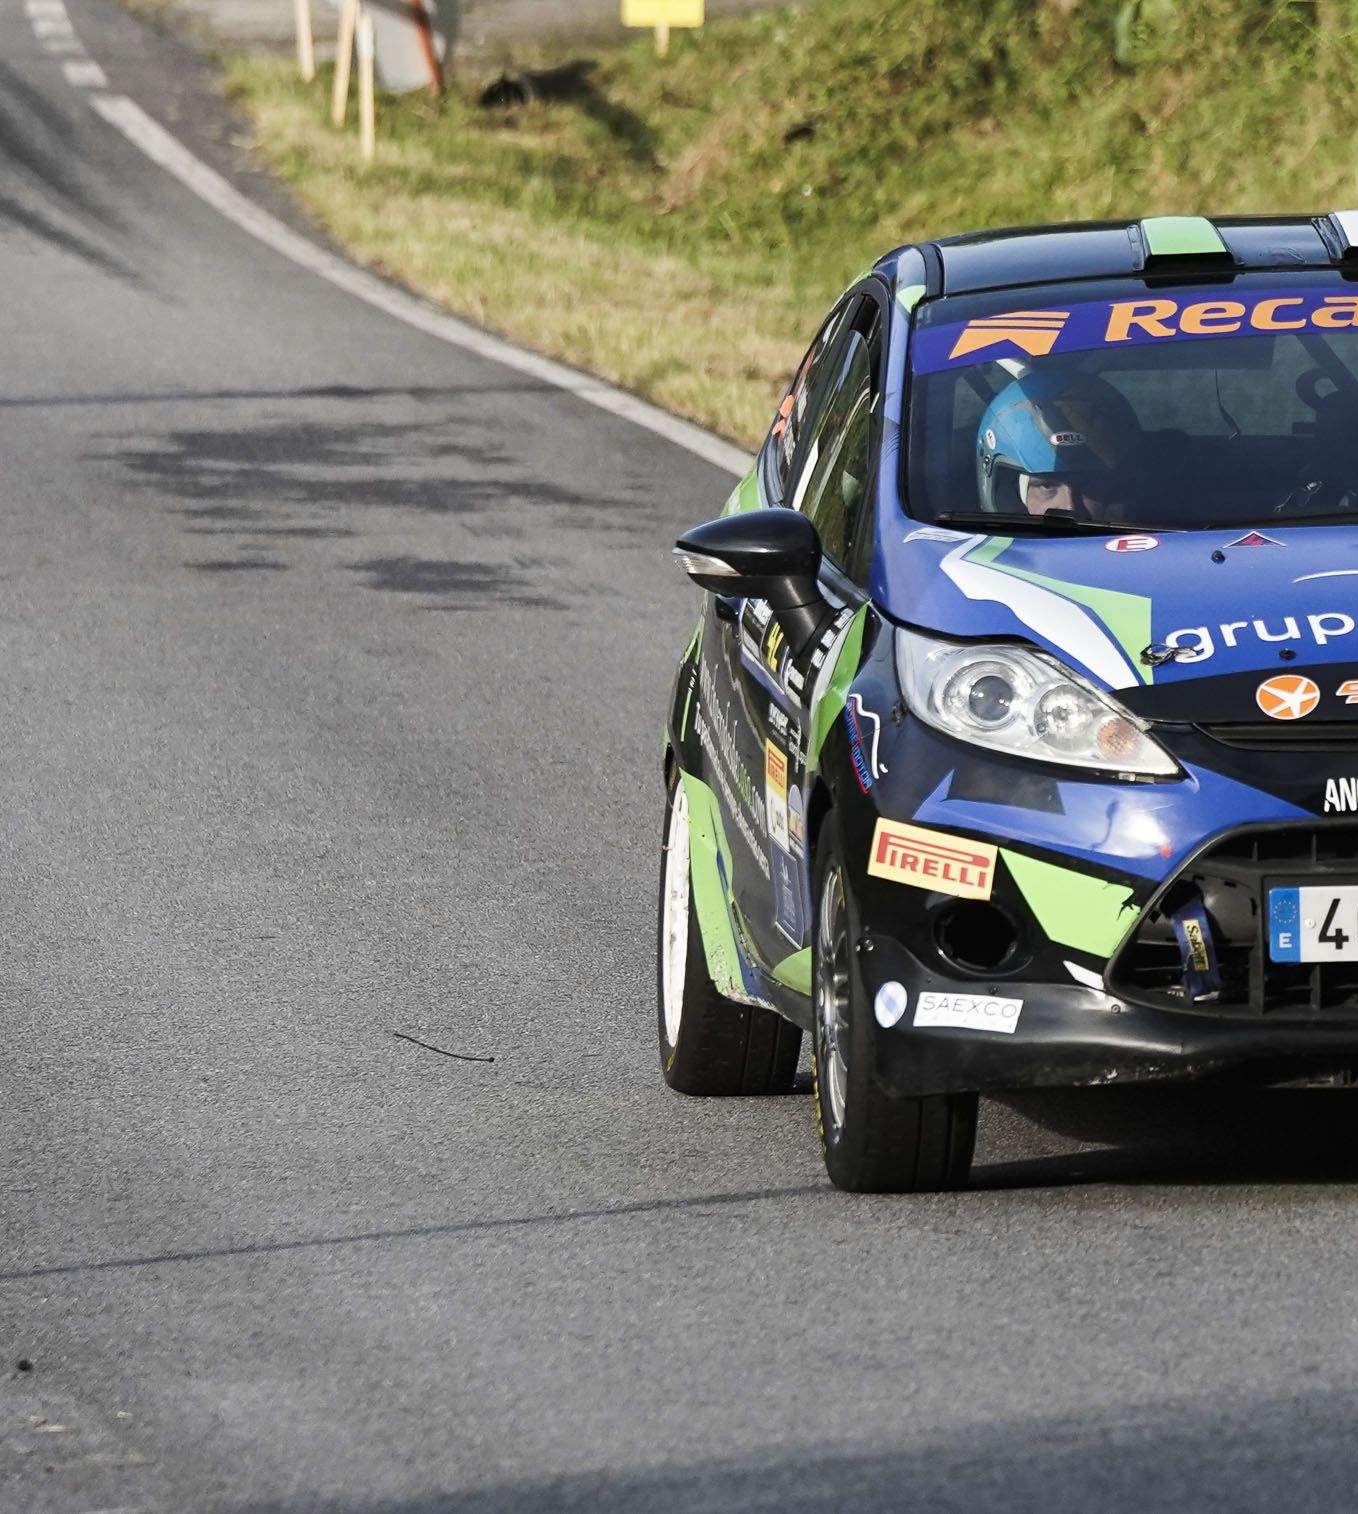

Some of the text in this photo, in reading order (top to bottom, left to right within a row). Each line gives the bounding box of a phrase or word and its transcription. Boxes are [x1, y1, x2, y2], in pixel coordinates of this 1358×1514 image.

[875, 831, 990, 889] PIRELLI
[1278, 932, 1292, 948] E
[922, 994, 1018, 1019] SAEXCO
